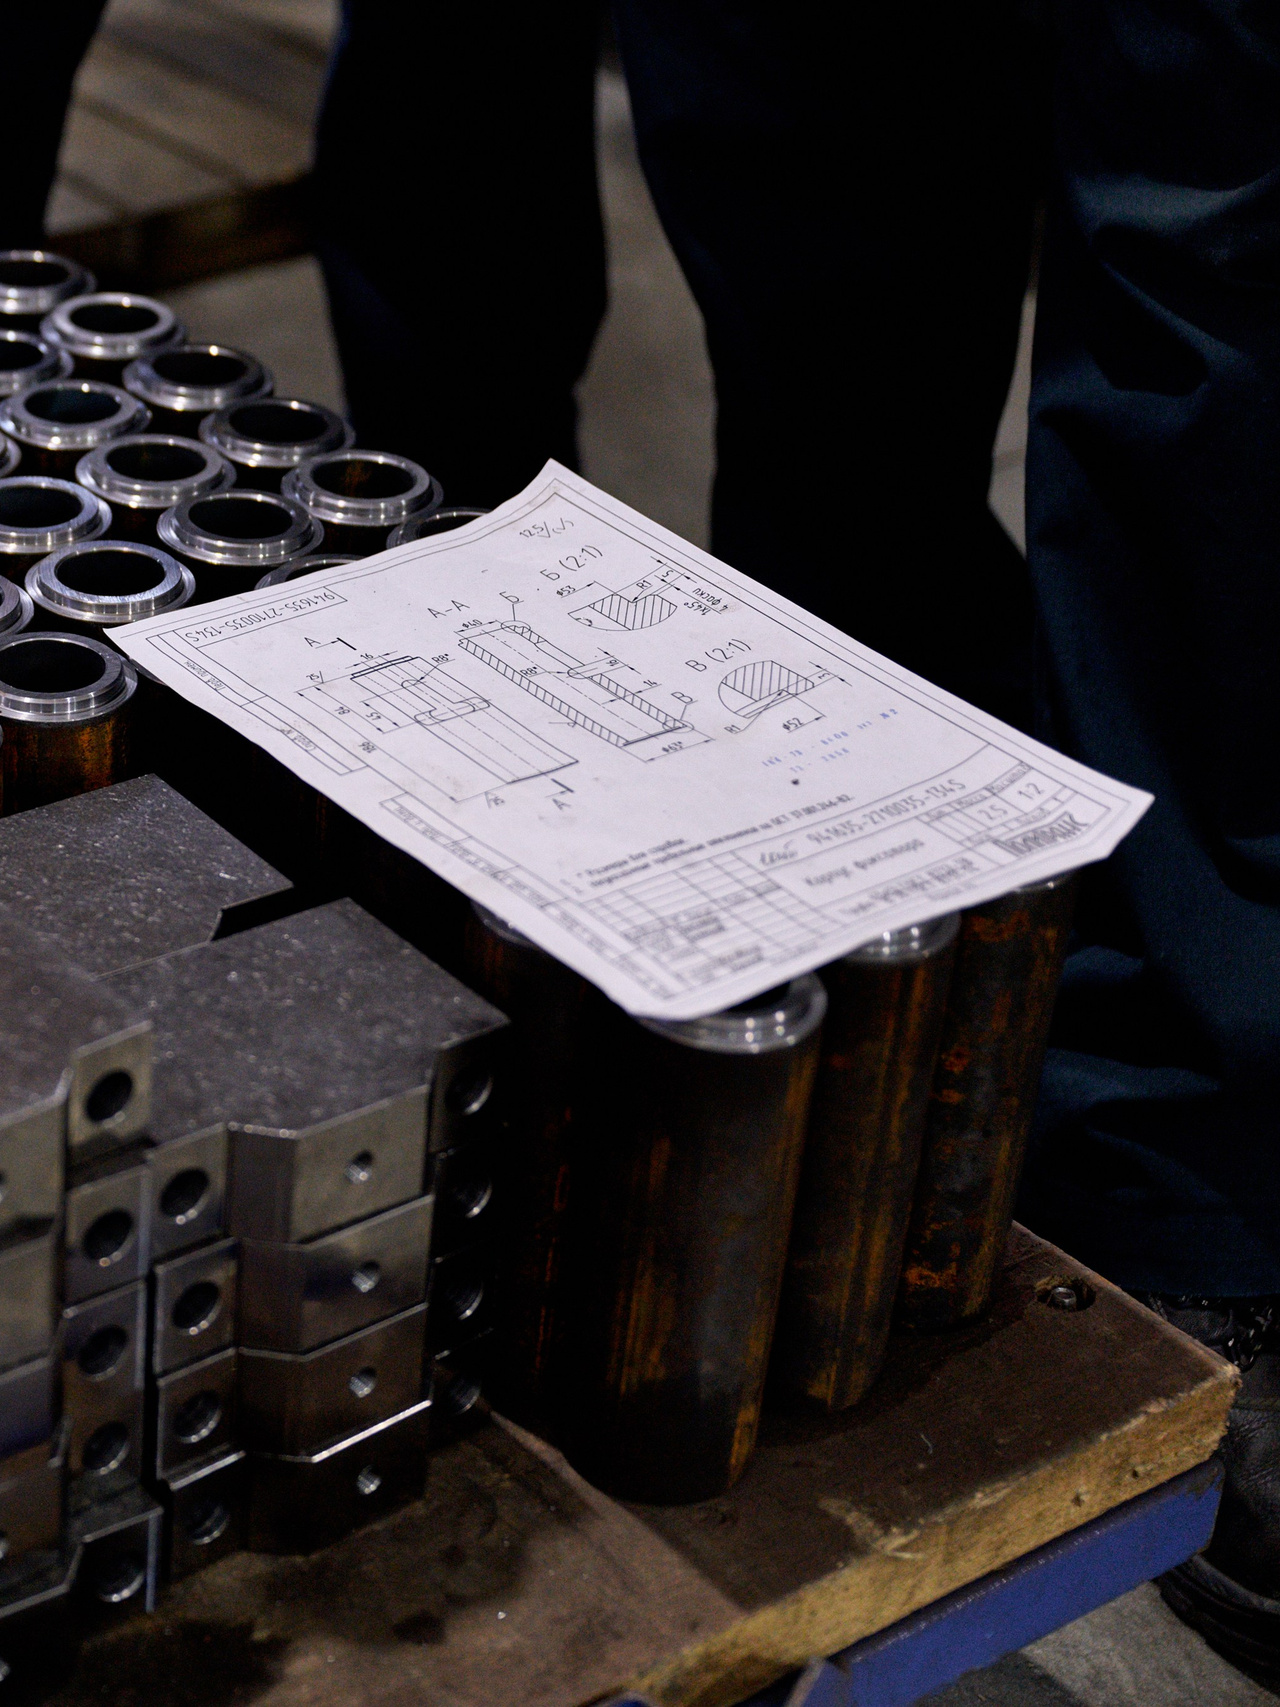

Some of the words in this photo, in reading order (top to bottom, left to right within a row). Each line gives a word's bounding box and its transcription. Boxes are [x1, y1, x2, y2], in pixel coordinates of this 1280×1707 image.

[540, 568, 560, 581] Б
[661, 569, 674, 578] 5
[636, 579, 652, 590] R1
[499, 591, 521, 604] Б
[692, 587, 722, 606] фаски
[360, 651, 374, 661] 16
[643, 679, 658, 688] 14
